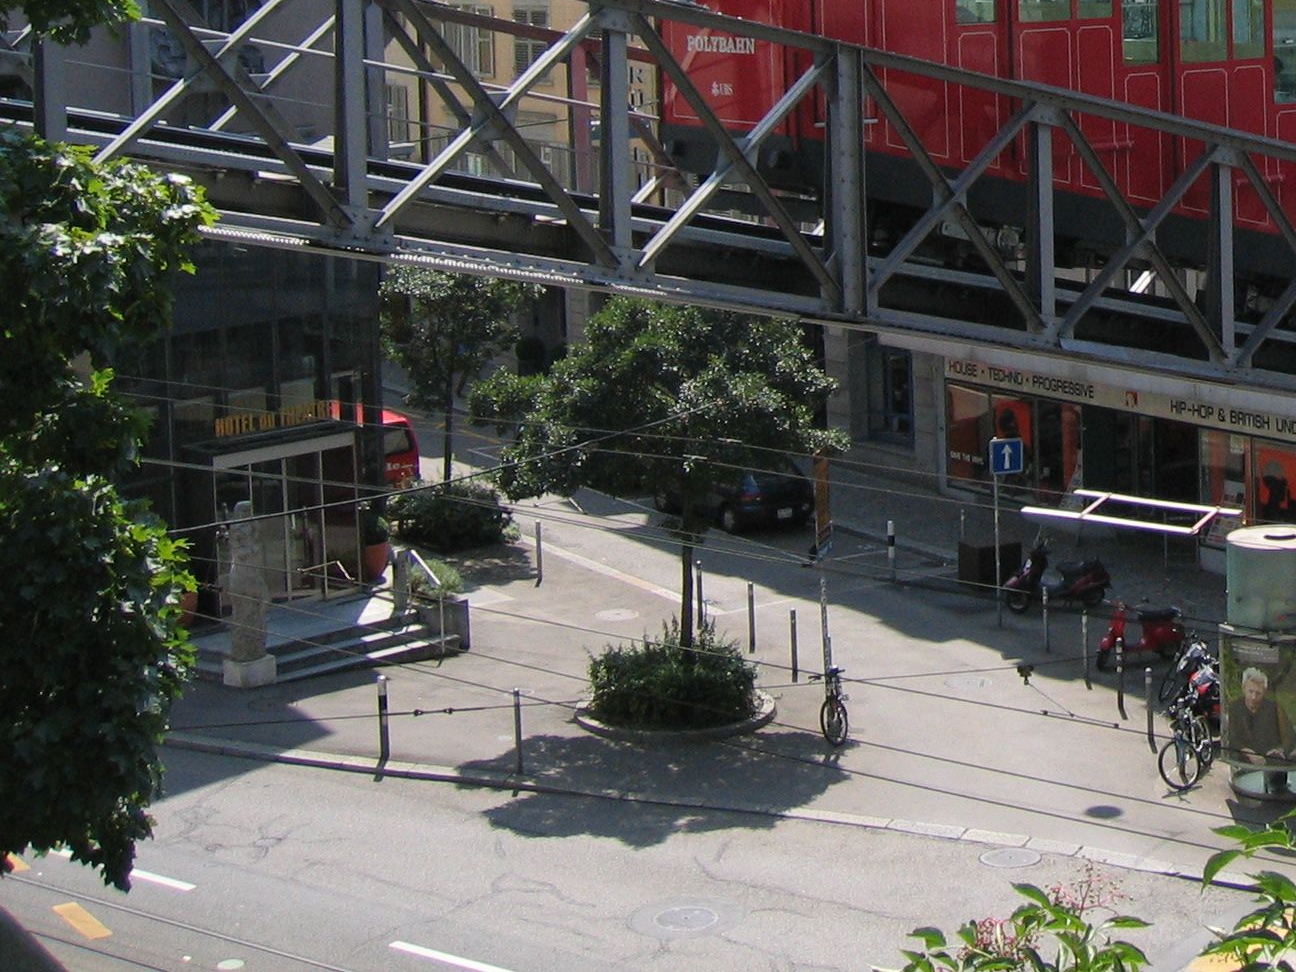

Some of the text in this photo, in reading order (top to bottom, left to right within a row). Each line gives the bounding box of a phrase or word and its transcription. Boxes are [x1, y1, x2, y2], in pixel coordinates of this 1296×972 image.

[686, 35, 756, 55] POLYBAHN
[948, 360, 1095, 399] HOUSE TECHNO PROGRESSIVE
[214, 413, 254, 437] HOTEL
[1170, 399, 1215, 421] HIP-HOP
[1217, 410, 1226, 422] &
[1229, 410, 1271, 431] BRITISH
